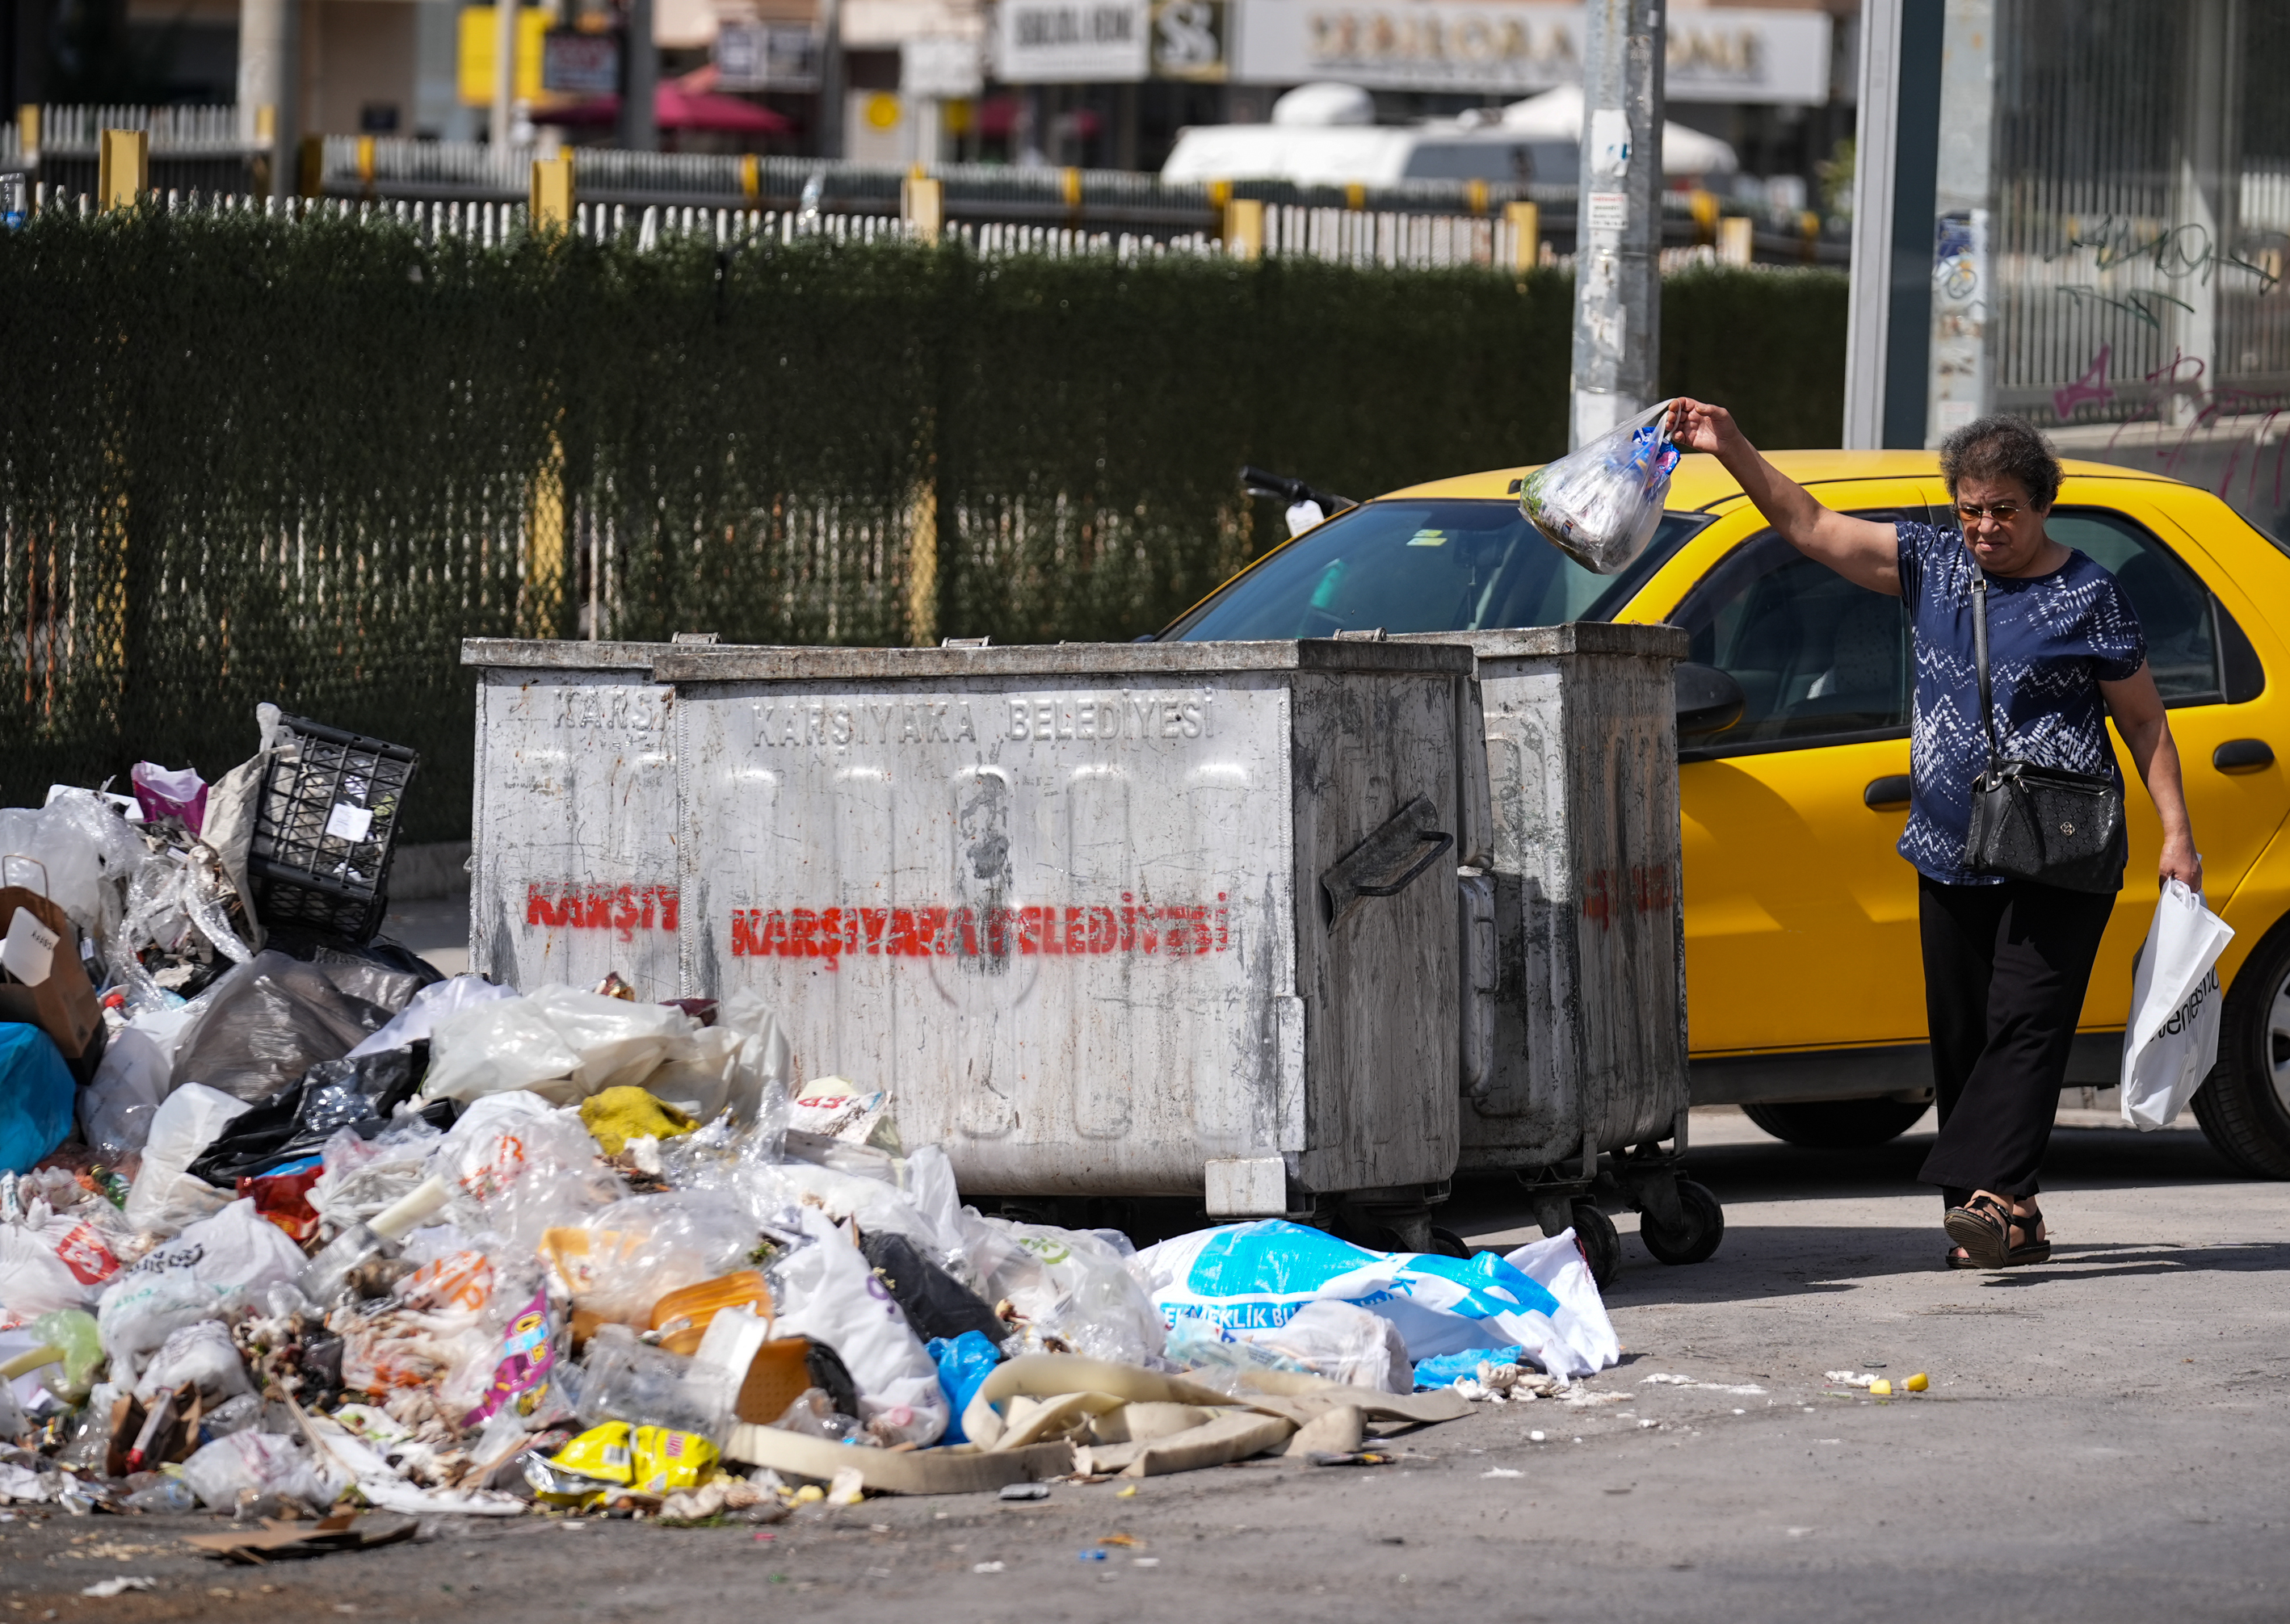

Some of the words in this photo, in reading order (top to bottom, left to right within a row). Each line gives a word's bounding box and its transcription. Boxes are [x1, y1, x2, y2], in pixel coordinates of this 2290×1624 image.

[752, 702, 977, 755] KARŞIYAKA
[1009, 686, 1212, 741] BELEDİYESİ
[731, 906, 978, 972] KARŞIYAKA
